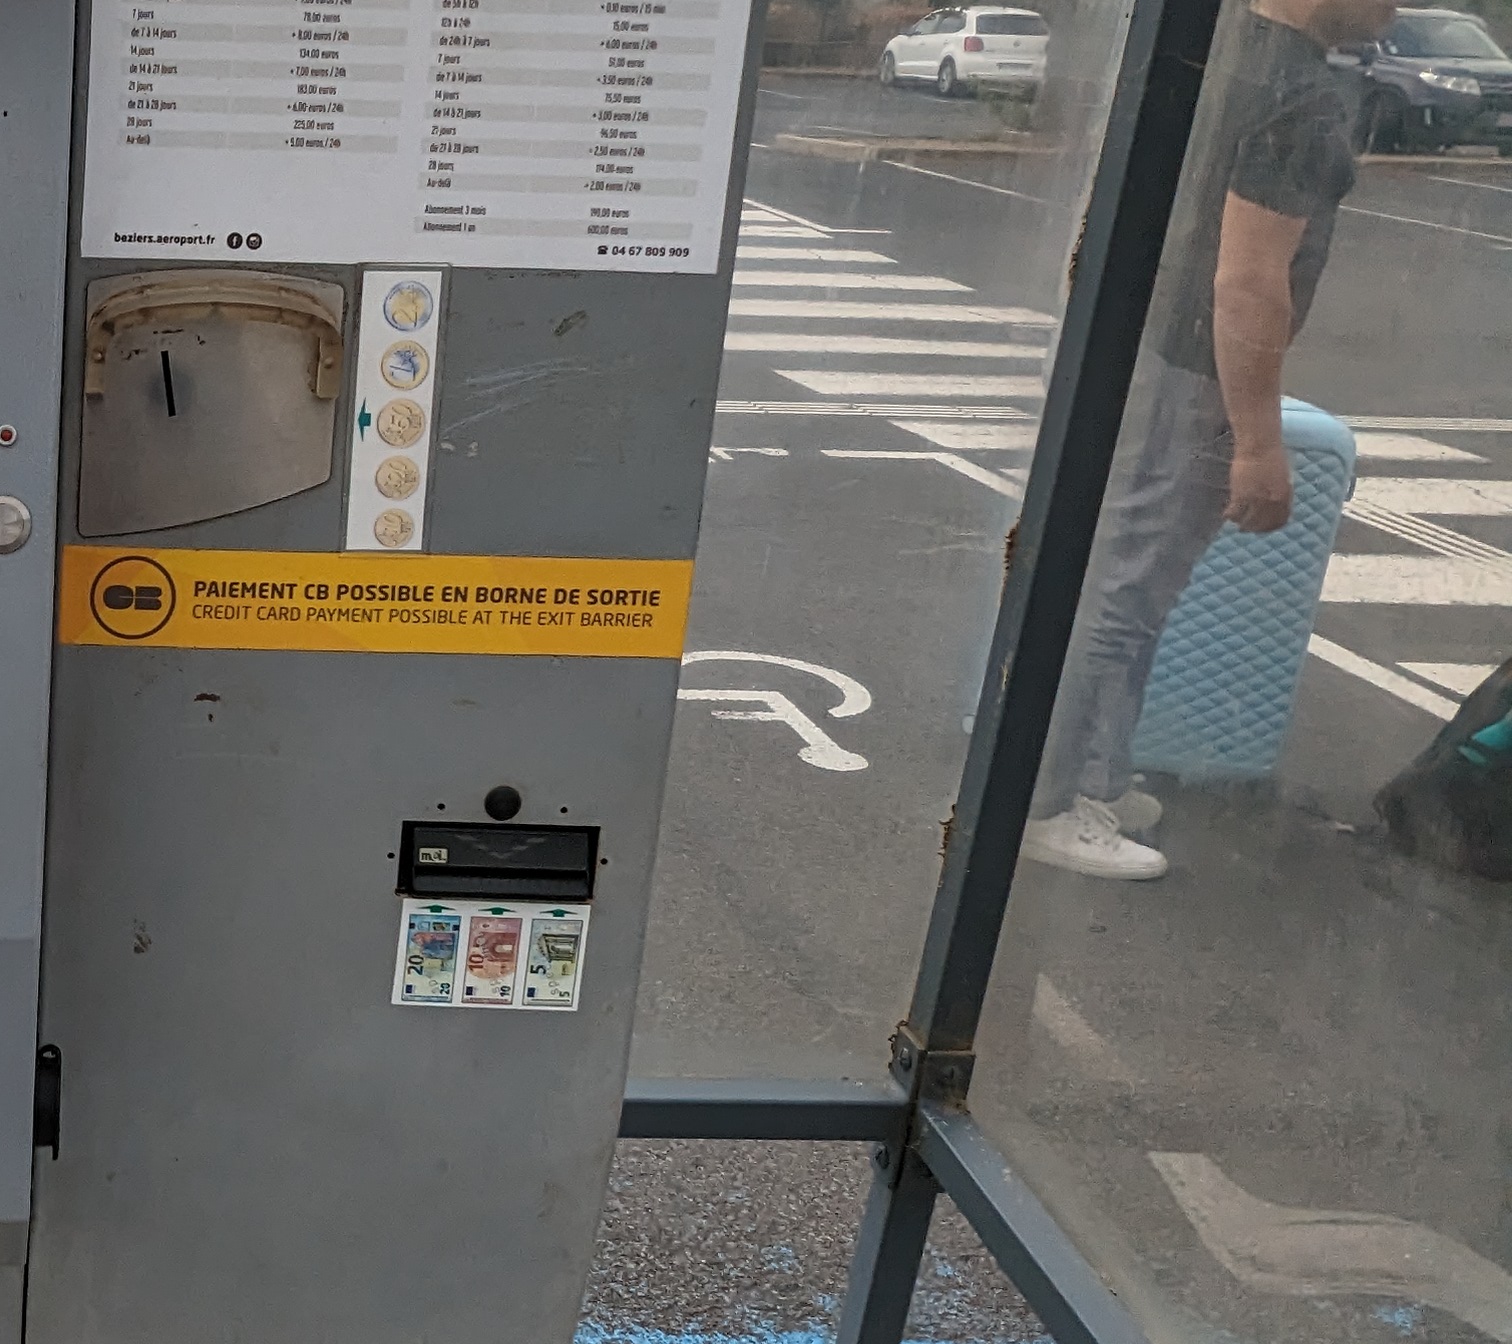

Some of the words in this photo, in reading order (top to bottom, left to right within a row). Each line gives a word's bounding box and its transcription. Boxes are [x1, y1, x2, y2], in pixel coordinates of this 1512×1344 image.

[114, 233, 215, 246] beziers.aeroport.fr
[612, 246, 626, 256] 04
[628, 247, 642, 257] 67
[645, 247, 666, 257] 809
[668, 247, 689, 257] 909
[194, 580, 298, 600] PAIEMENT
[303, 584, 330, 600] CB
[336, 584, 434, 603] POSSIBLE
[441, 586, 469, 603] EN
[475, 586, 548, 604] BORNE
[553, 588, 581, 605] DE
[587, 589, 662, 607] SORTIE
[192, 604, 252, 620] CREDIT
[256, 606, 301, 621] CARD
[306, 607, 384, 623] PAYMENT
[389, 608, 468, 625] POSSIBLE
[472, 610, 493, 625] AT
[499, 611, 532, 626] THE
[538, 612, 575, 626] EXIT
[580, 613, 654, 628] BARRIER
[407, 954, 424, 976] 20
[468, 954, 484, 972] 10
[530, 964, 547, 975] 5
[439, 982, 451, 995] 20
[499, 985, 511, 997] 10
[559, 990, 570, 998] 5
